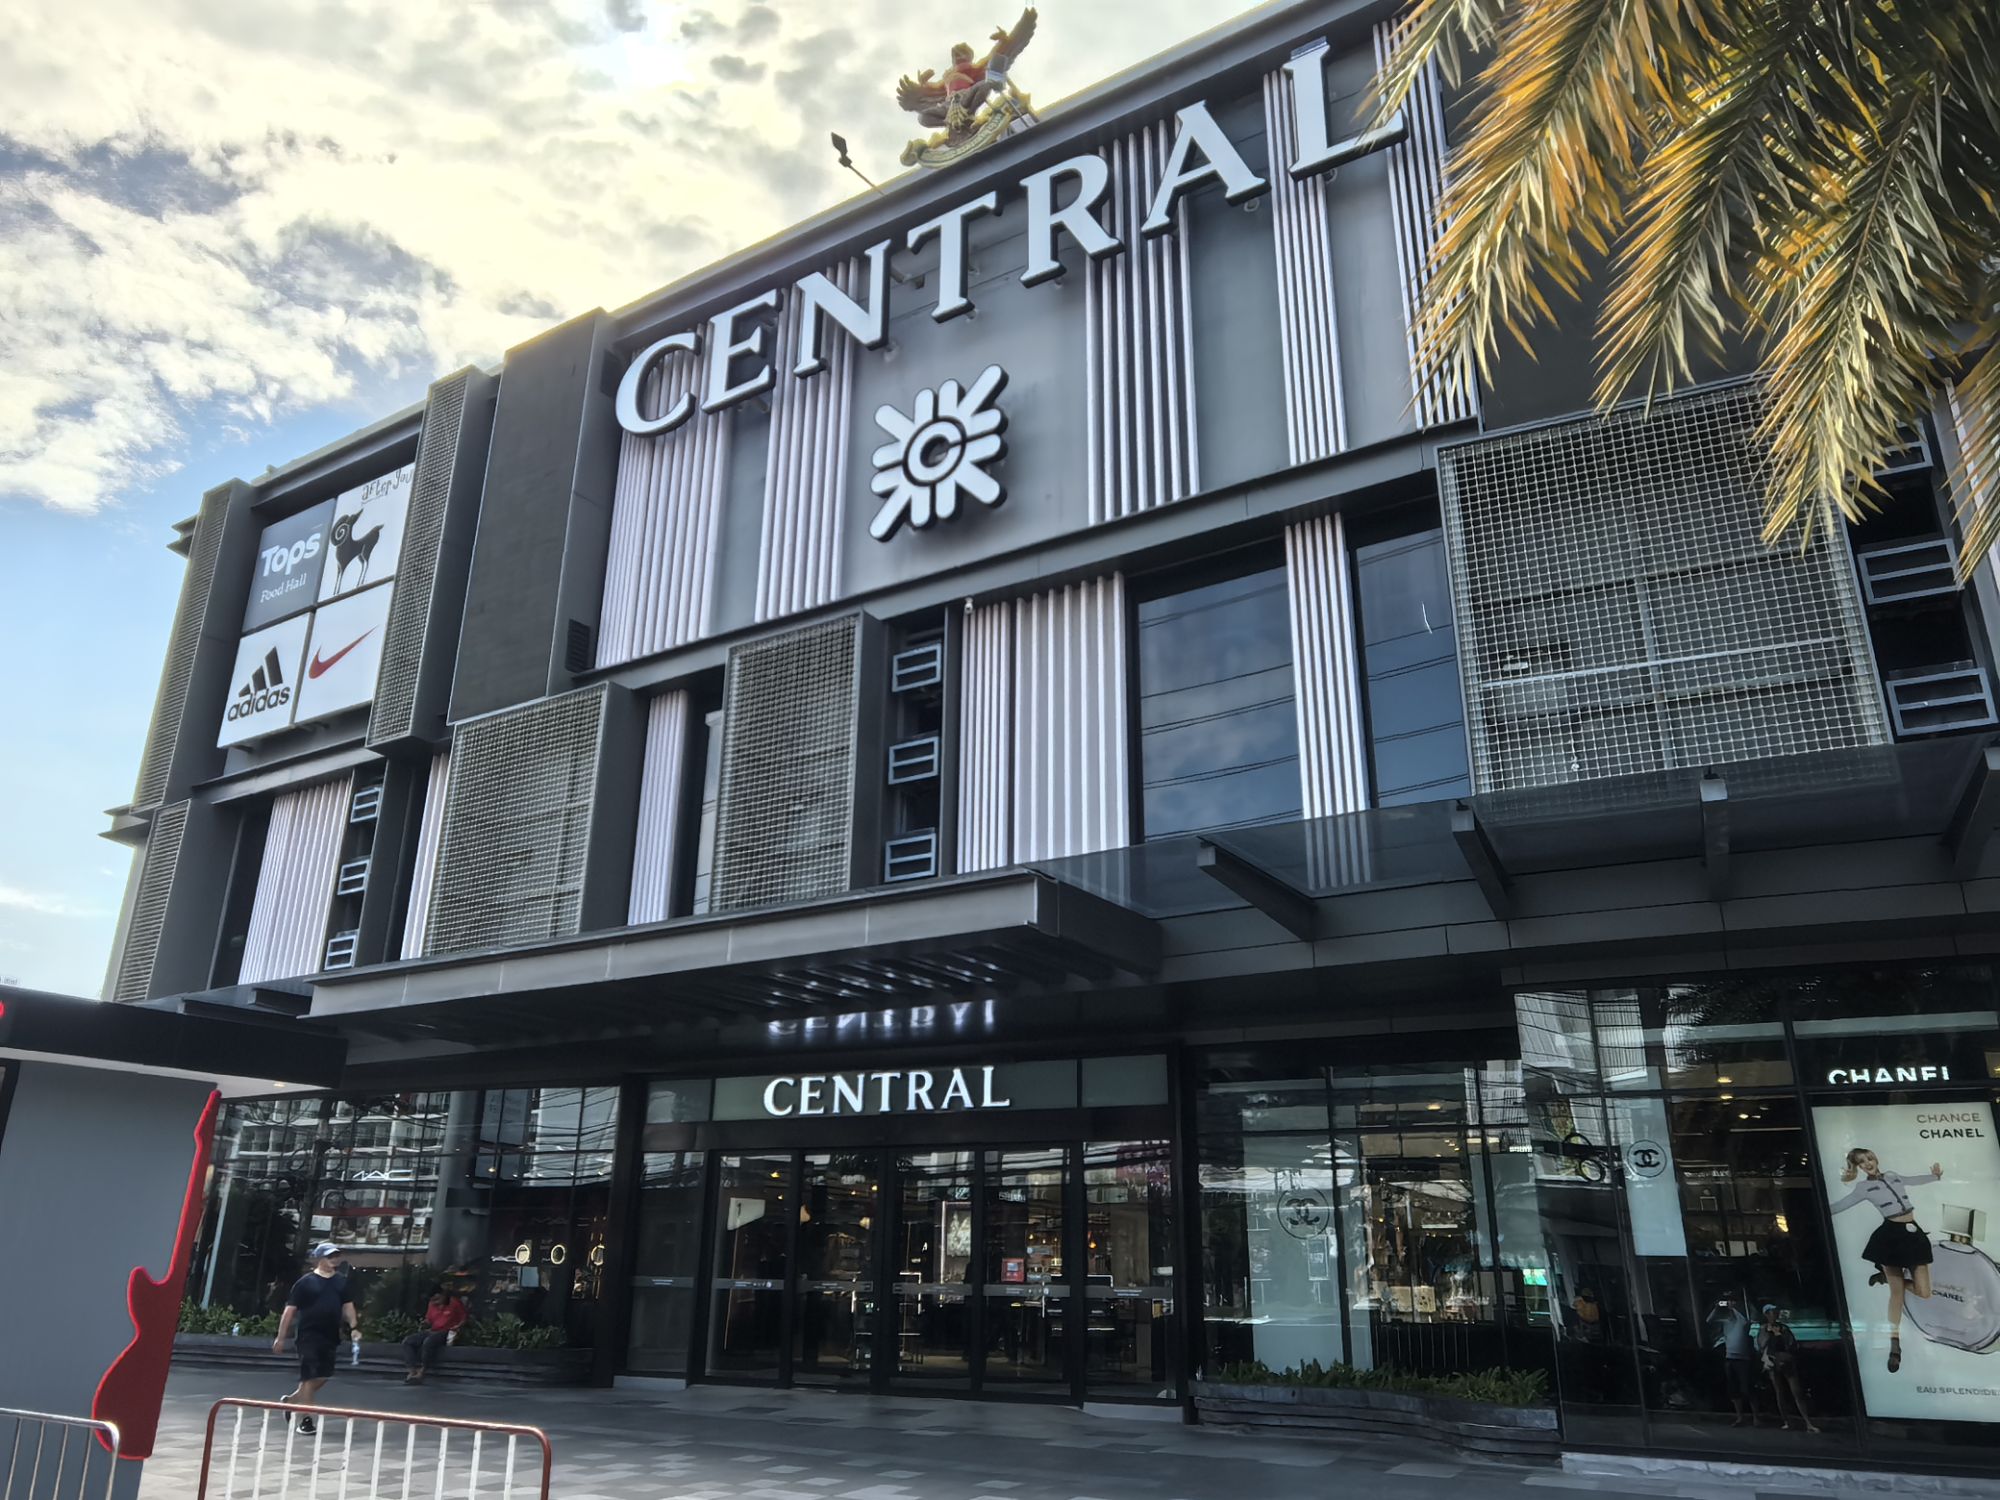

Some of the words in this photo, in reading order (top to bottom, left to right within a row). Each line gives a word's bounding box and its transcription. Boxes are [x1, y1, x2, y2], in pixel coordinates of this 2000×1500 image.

[614, 40, 1406, 439] CENTRAL
[261, 533, 321, 577] Tops
[260, 582, 285, 603] Food
[286, 573, 307, 593] Hall
[227, 686, 291, 721] adidas
[763, 1066, 1011, 1116] CENTRAL
[1916, 1112, 1982, 1124] CHANCE
[1919, 1128, 1985, 1139] CHANEL
[1916, 1385, 1937, 1394] EAU
